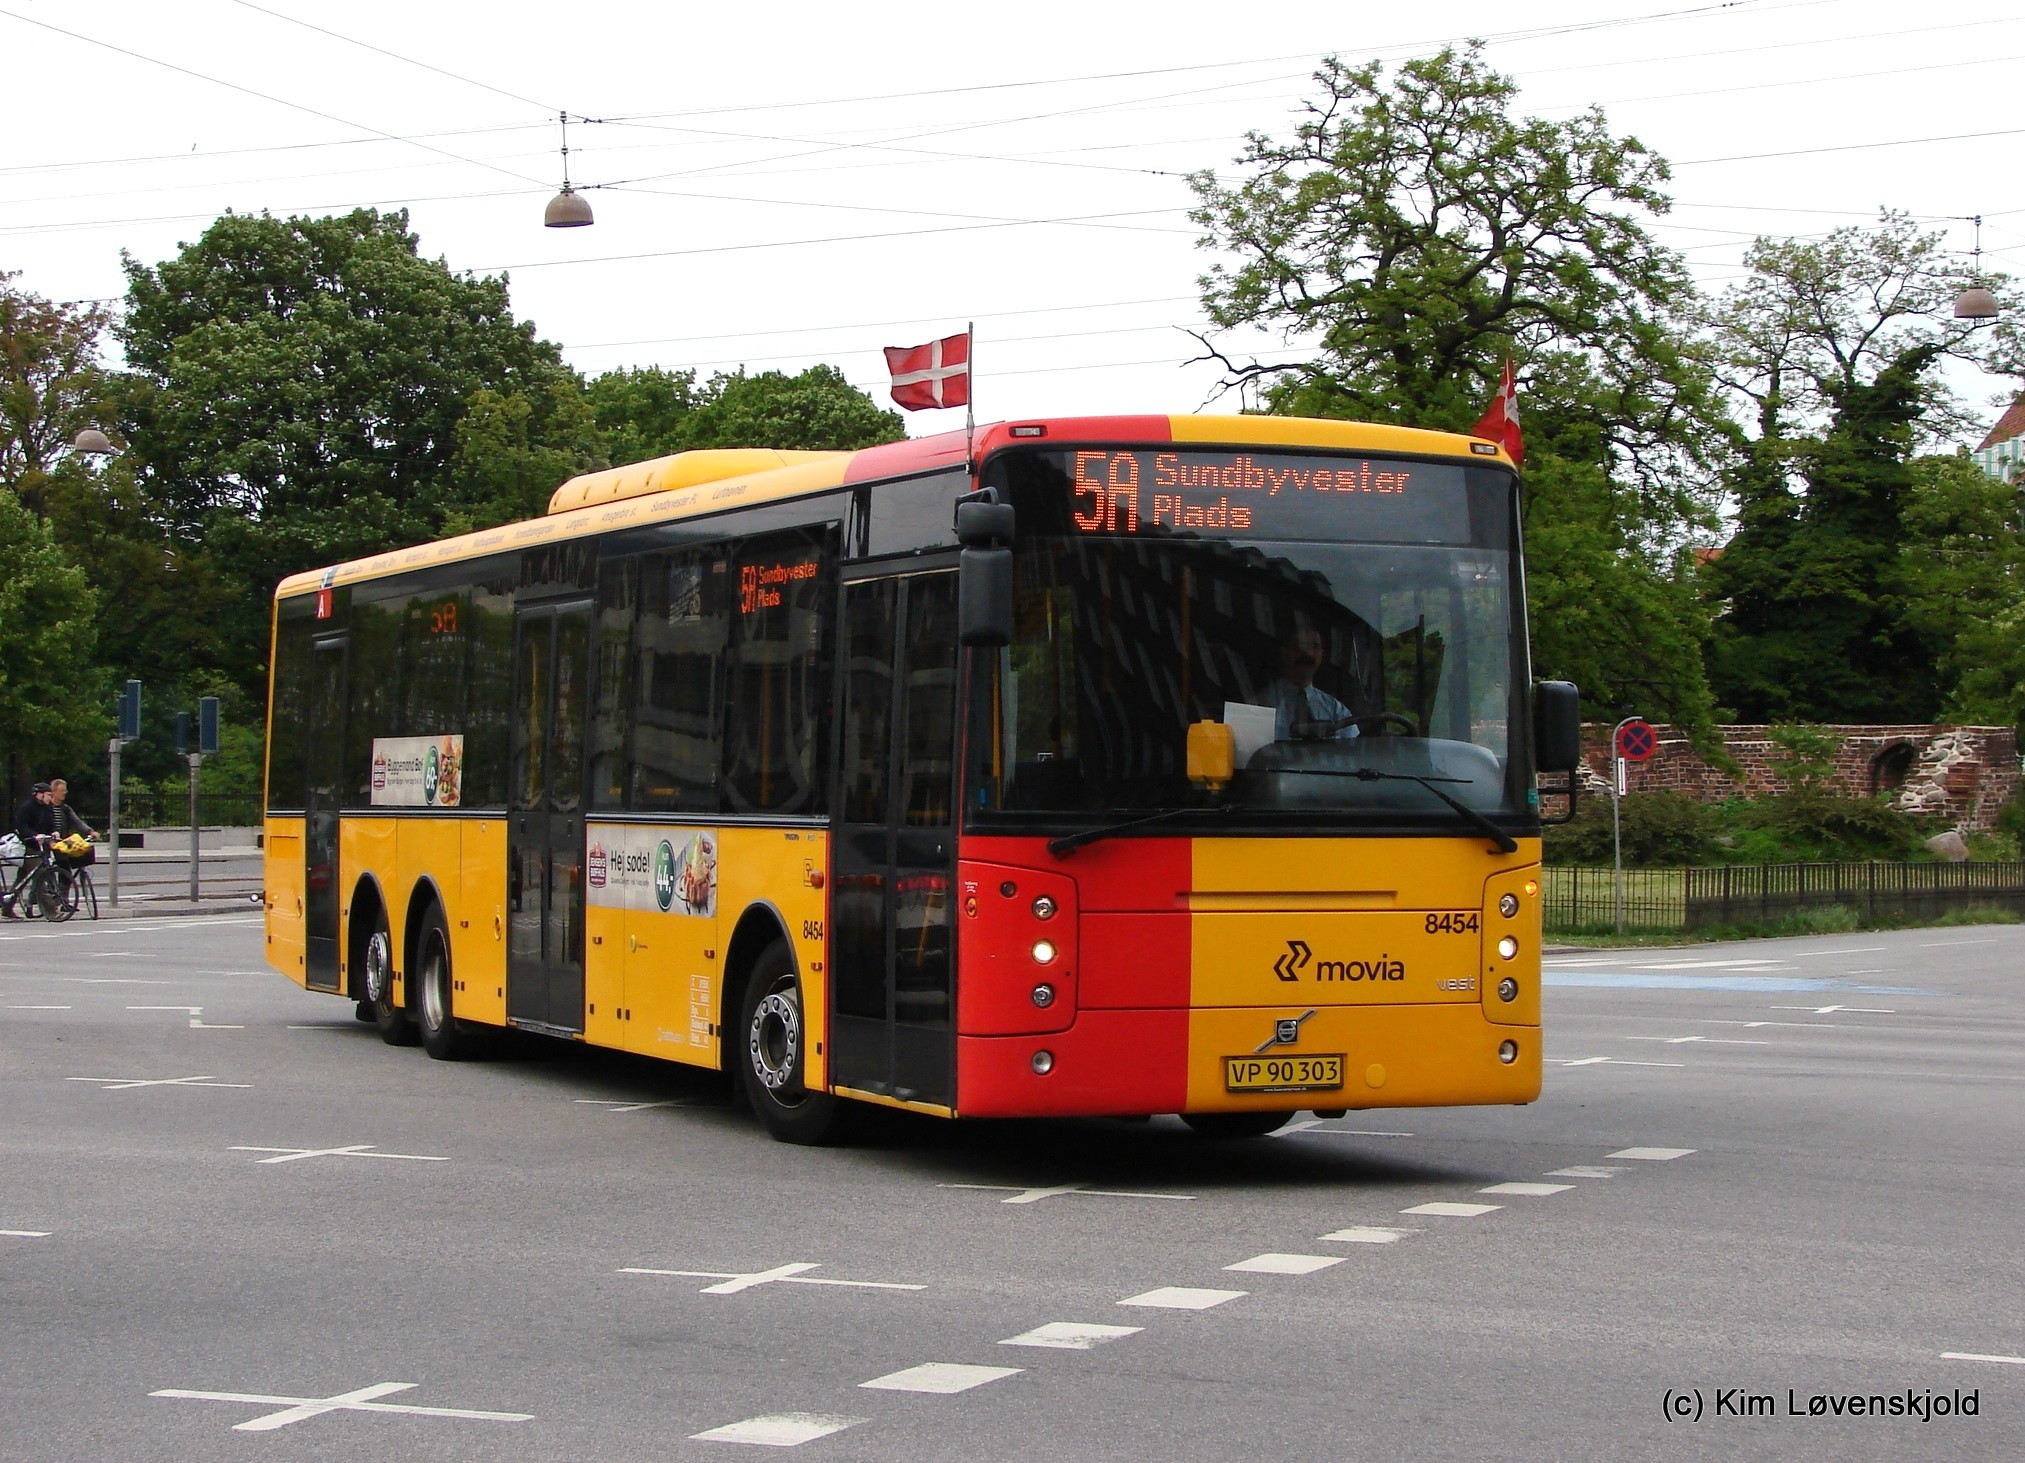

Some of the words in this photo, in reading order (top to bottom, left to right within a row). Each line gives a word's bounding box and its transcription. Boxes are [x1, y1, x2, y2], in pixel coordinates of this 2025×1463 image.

[1154, 453, 1410, 495] Sundbyvester
[1074, 451, 1139, 532] 5A
[1153, 494, 1252, 528] Plads
[759, 560, 817, 585] Sundbyvester
[758, 588, 780, 608] Plads
[610, 849, 625, 877] Hej
[626, 851, 650, 873] søde!
[803, 919, 823, 941] 8454
[1425, 913, 1479, 934] 8454
[1316, 953, 1405, 982] movia
[1436, 975, 1475, 992] vest
[1231, 1063, 1262, 1083] VP
[1267, 1062, 1294, 1082] 90
[1298, 1061, 1338, 1082] 303
